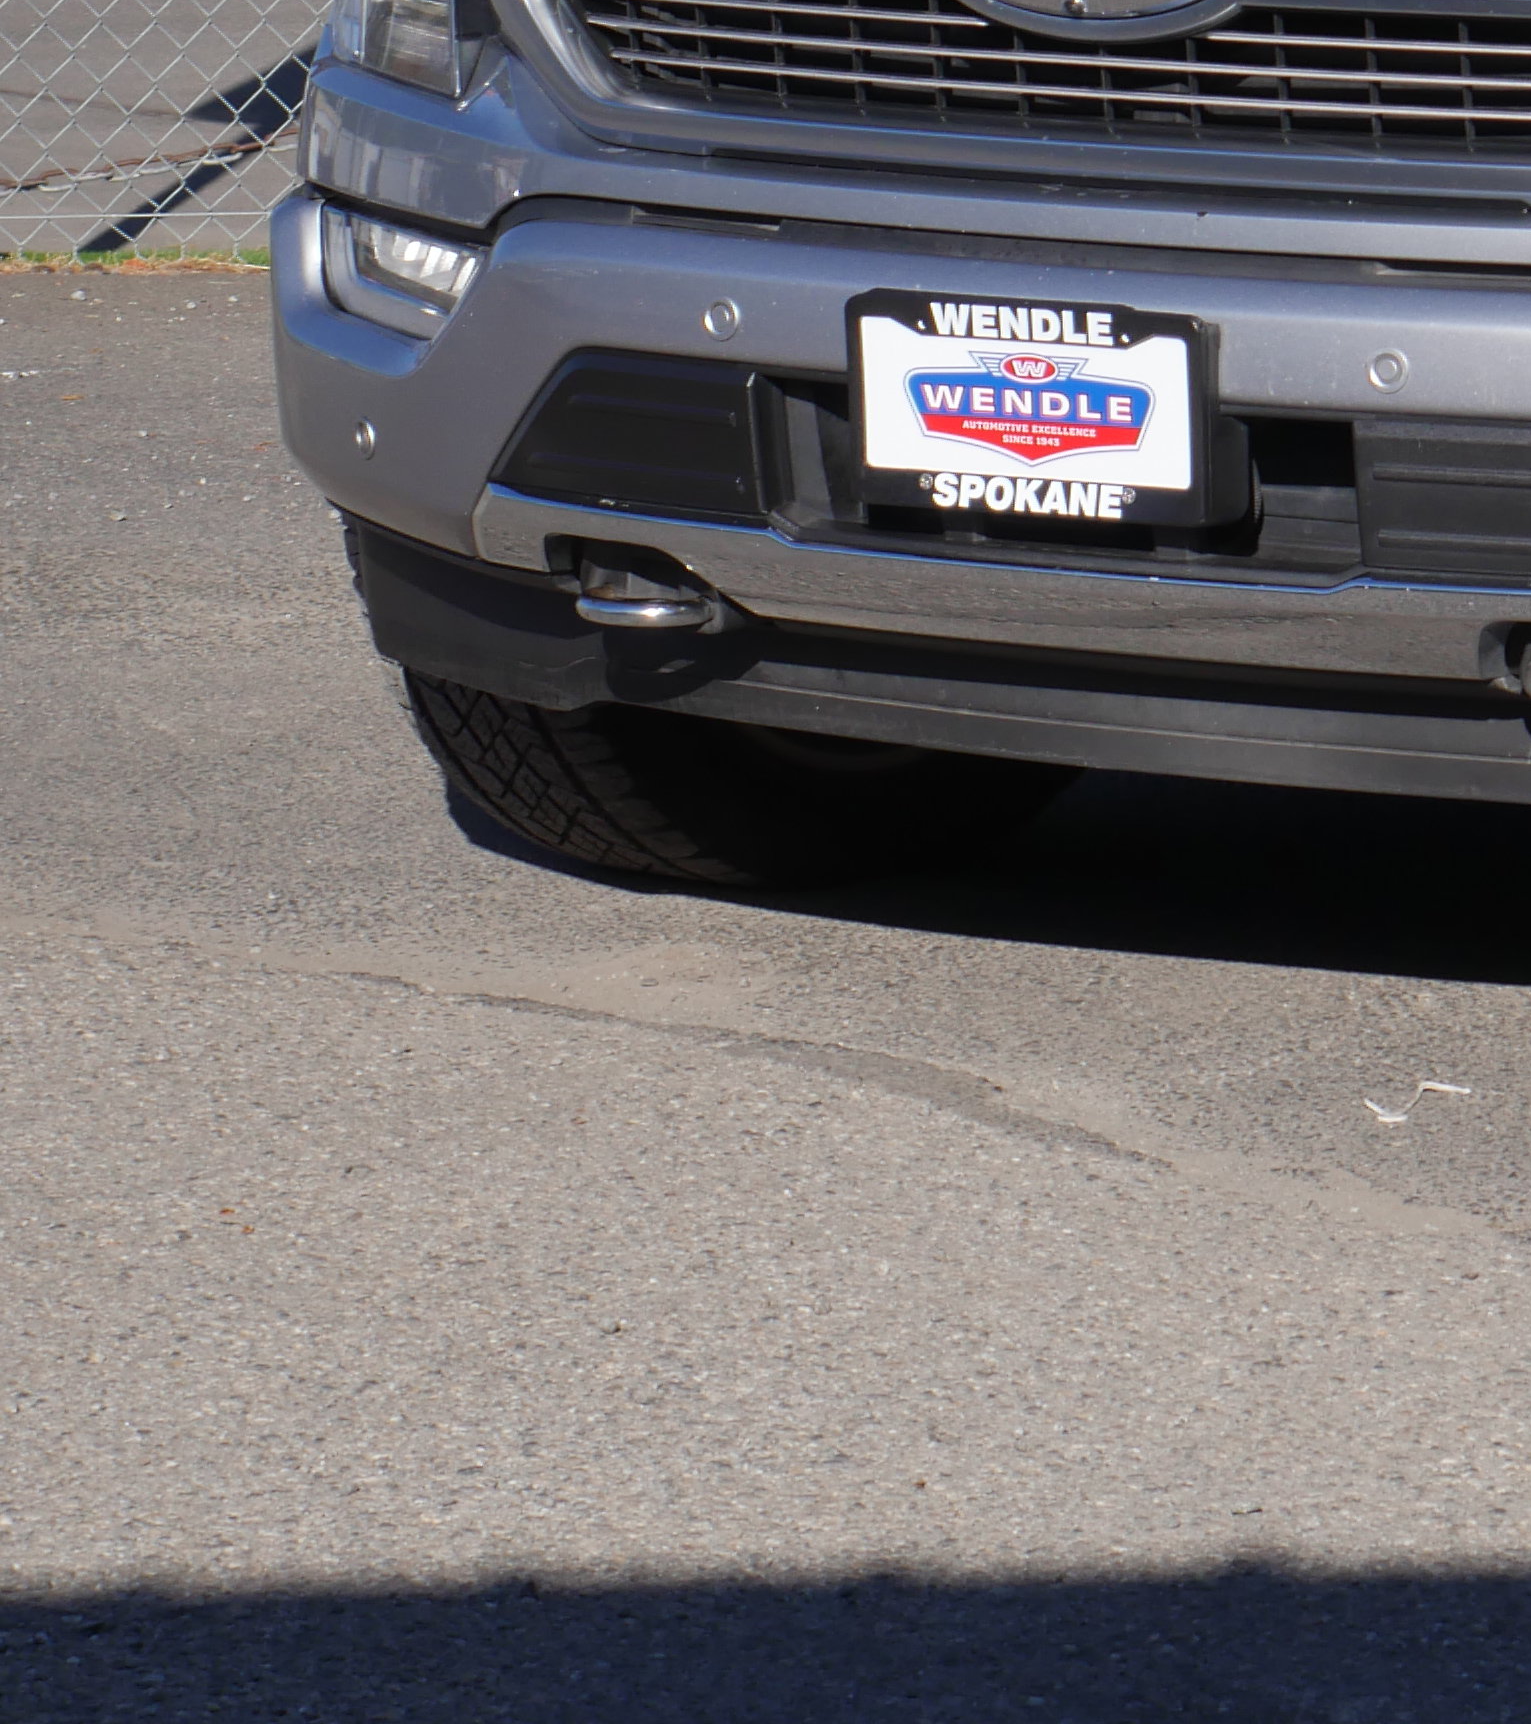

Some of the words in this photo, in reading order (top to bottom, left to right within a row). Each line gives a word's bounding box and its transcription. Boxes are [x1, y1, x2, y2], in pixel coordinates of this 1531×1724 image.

[929, 301, 1114, 347] WENDLE
[921, 383, 1133, 422] WENDLE
[961, 420, 1029, 434] AUTOMOTIVE
[1031, 424, 1097, 438] EXCELLENCE
[1001, 434, 1033, 444] SINCE
[931, 471, 1124, 520] SPOKANE
